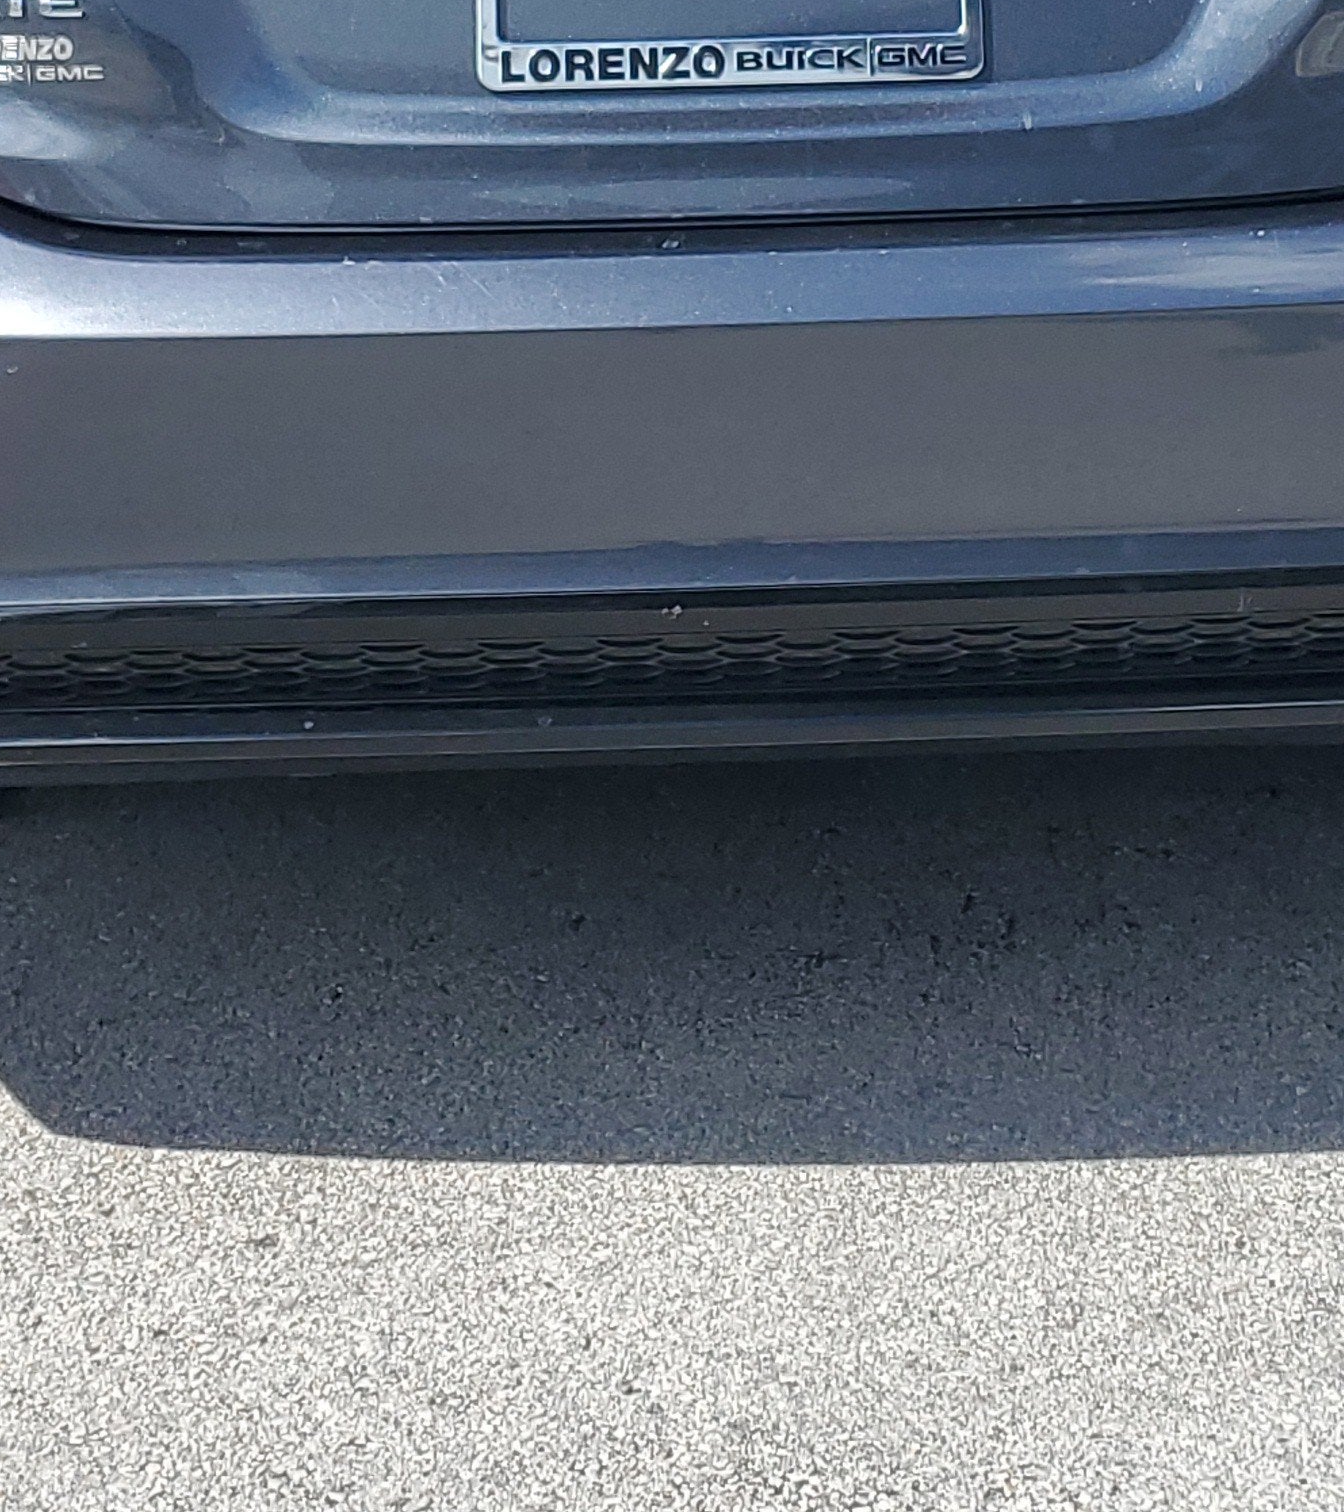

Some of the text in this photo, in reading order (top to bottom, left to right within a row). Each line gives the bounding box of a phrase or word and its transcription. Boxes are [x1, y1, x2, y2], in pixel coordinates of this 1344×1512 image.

[36, 64, 106, 83] GMC
[500, 44, 968, 84] LORENZO BUICK GMC
